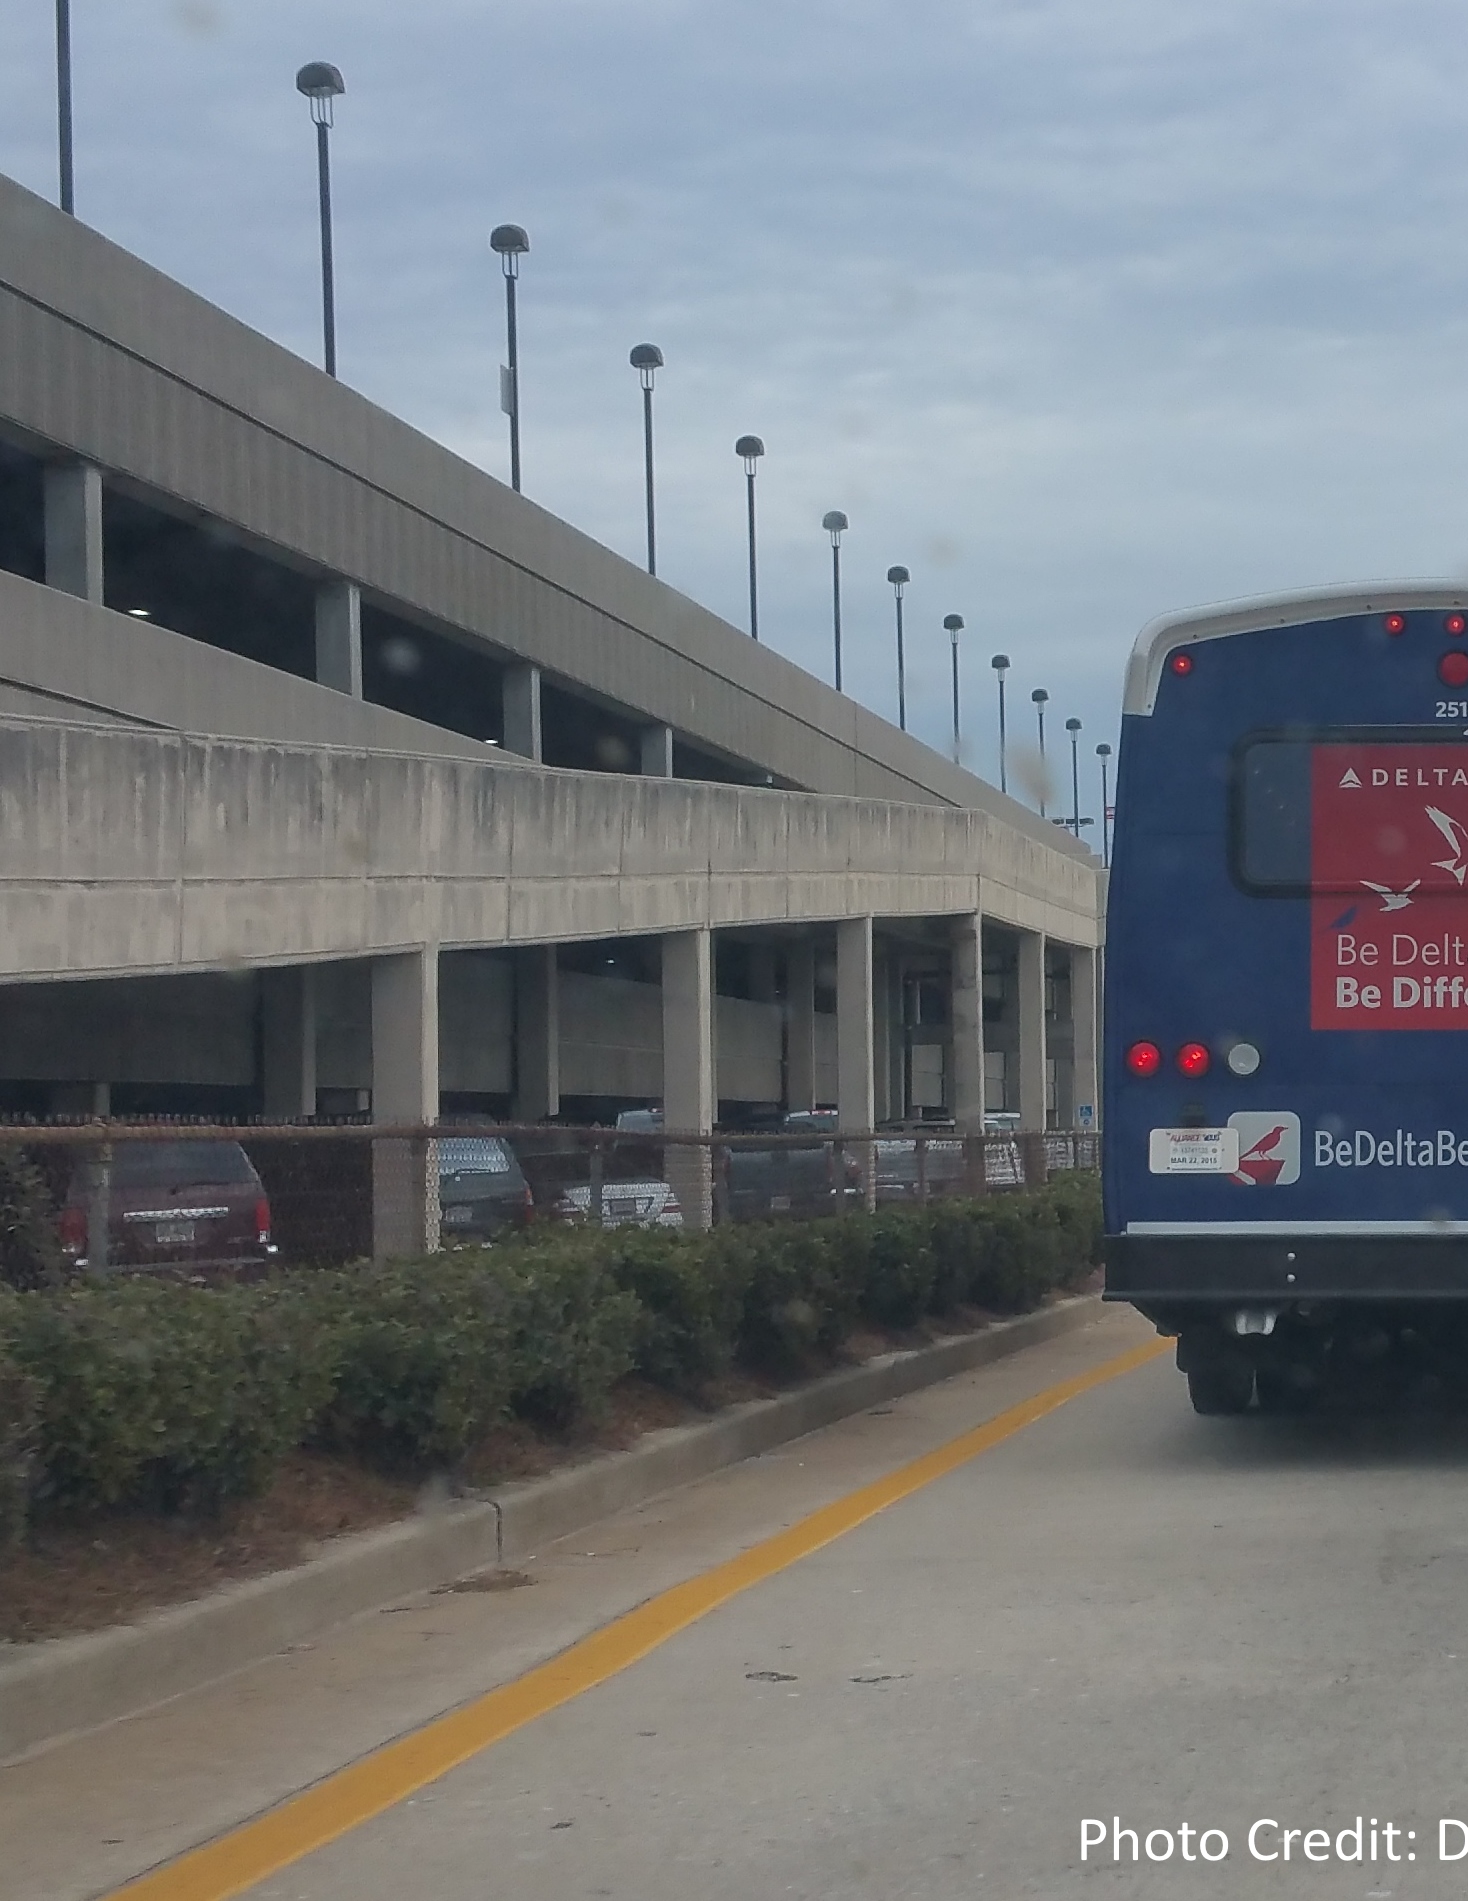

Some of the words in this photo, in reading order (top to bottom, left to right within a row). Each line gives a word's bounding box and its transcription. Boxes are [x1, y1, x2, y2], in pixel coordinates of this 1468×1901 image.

[1372, 768, 1468, 786] DELTA
[1337, 934, 1379, 966] Be
[1336, 977, 1382, 1009] Be
